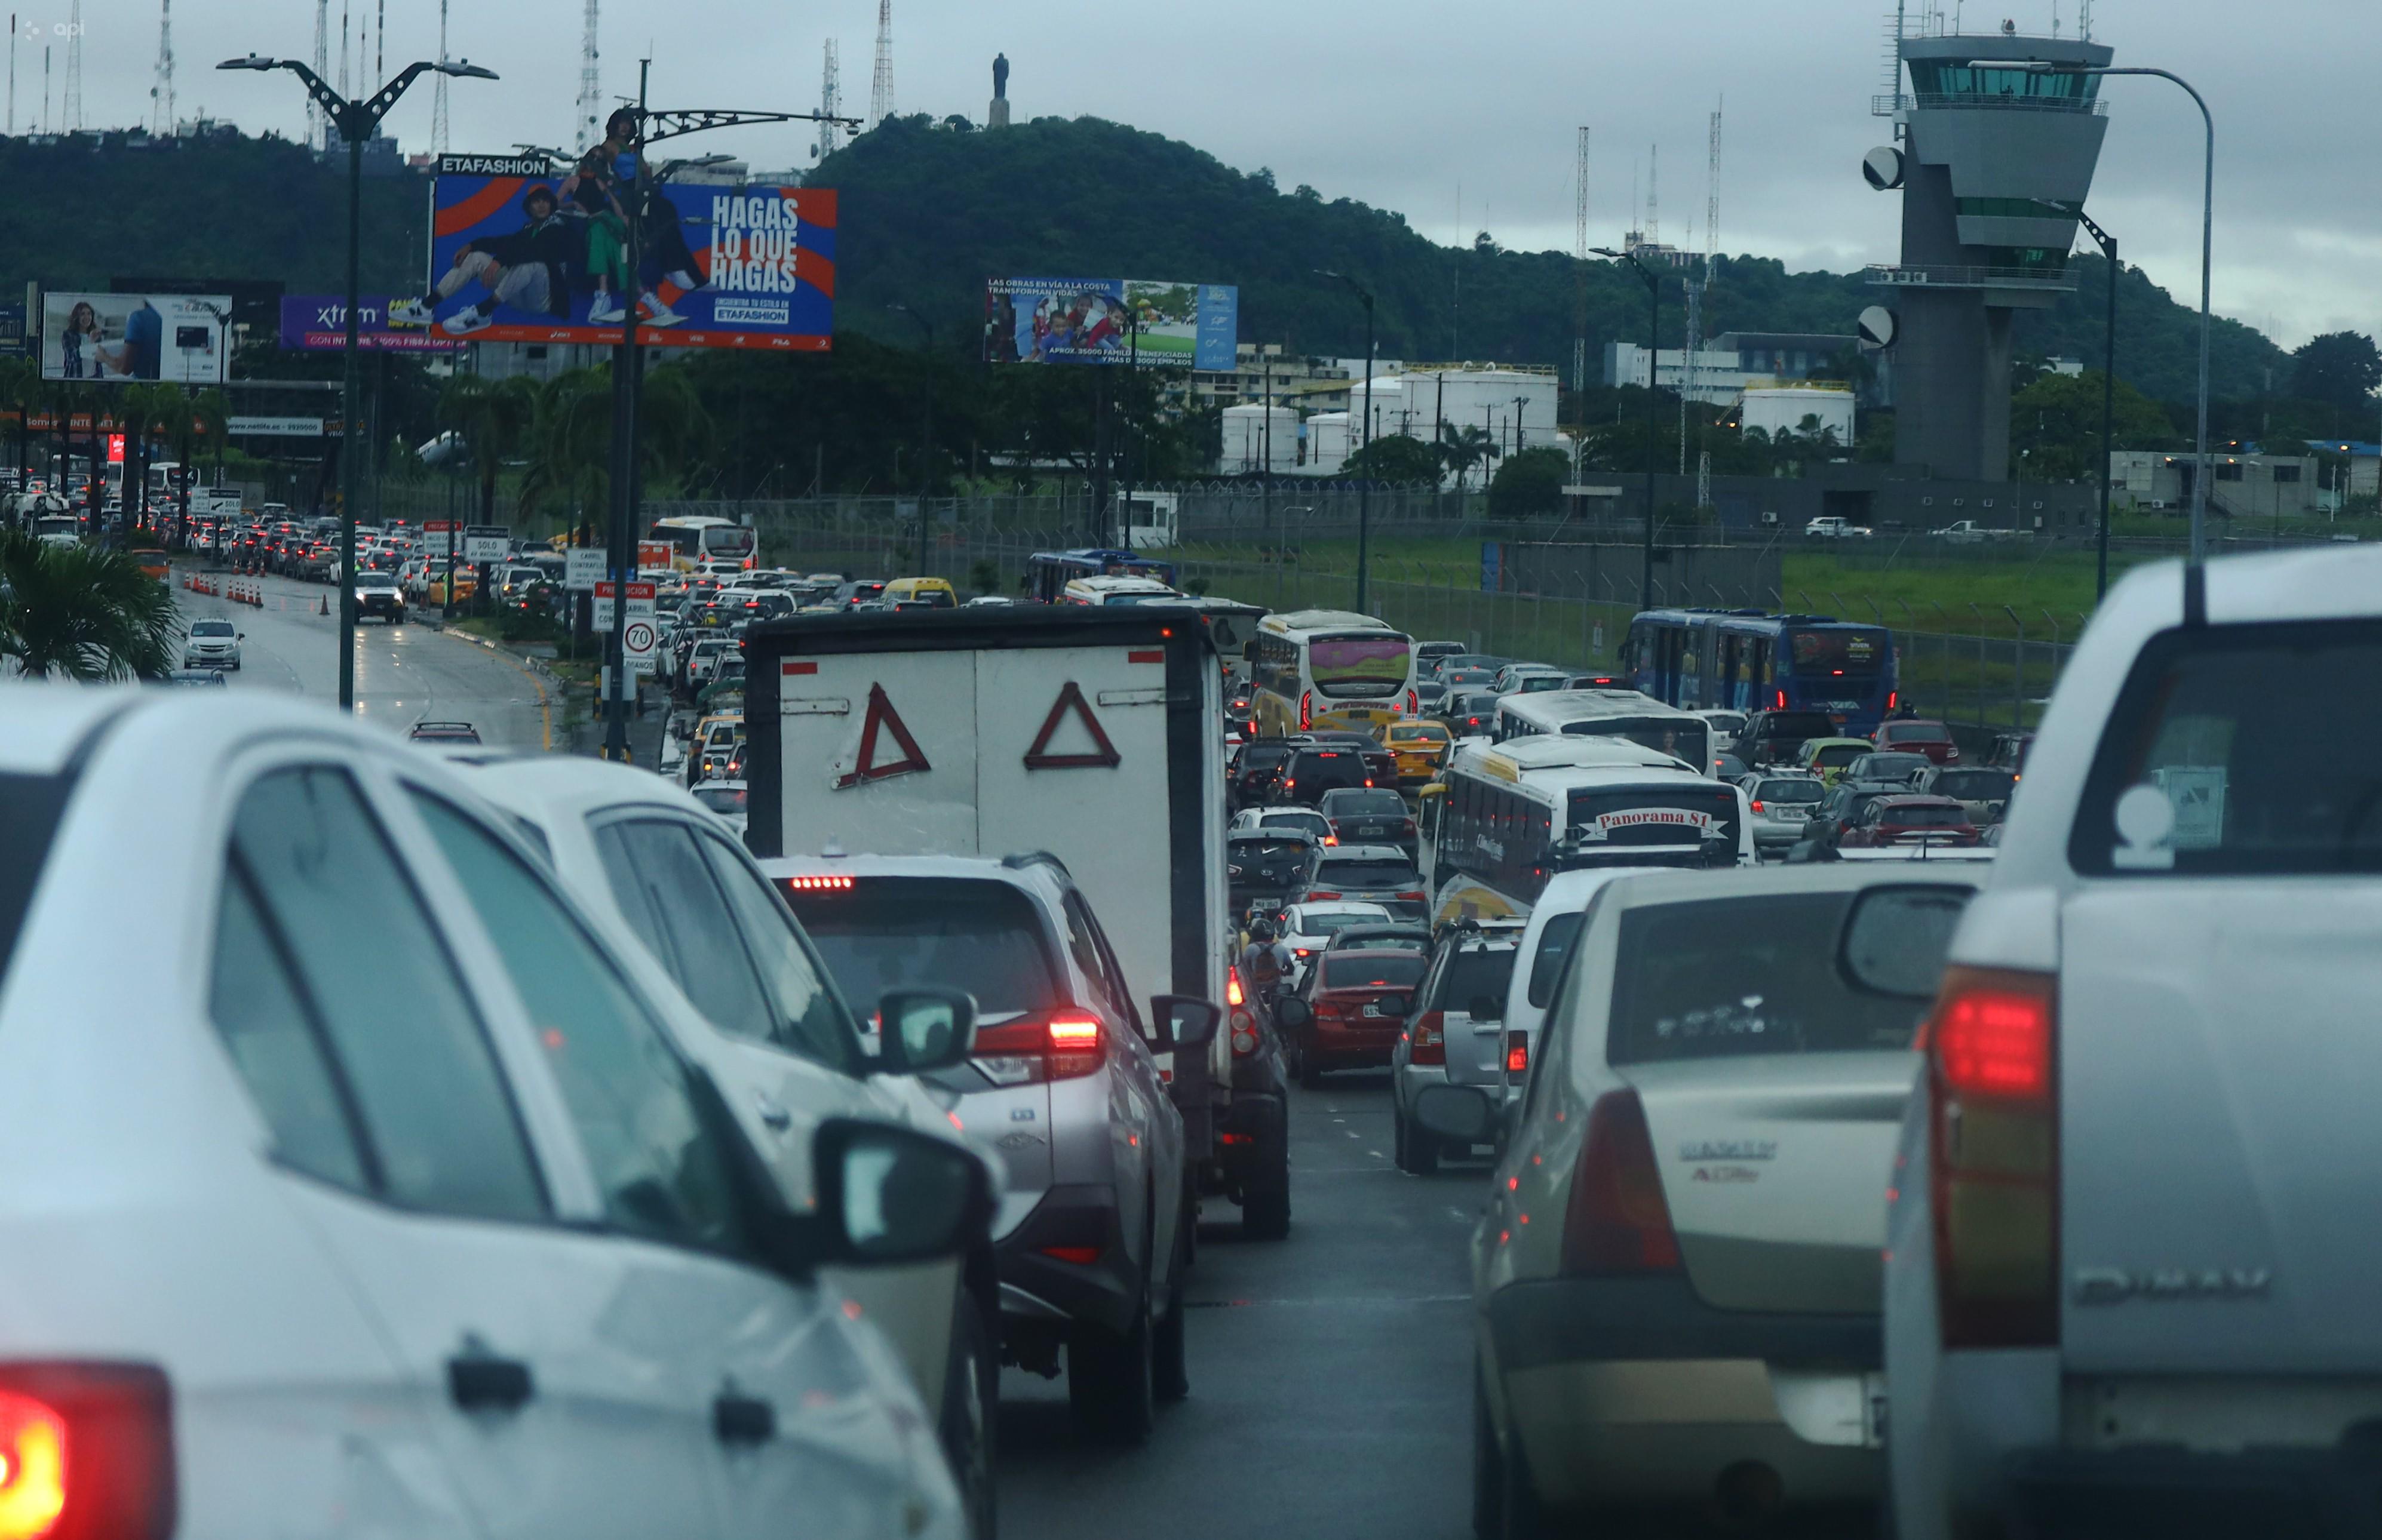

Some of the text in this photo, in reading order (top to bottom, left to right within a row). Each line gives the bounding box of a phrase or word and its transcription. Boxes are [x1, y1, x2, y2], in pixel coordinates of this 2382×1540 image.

[441, 157, 547, 175] ETAFASHION
[712, 195, 799, 230] HAGAS
[710, 225, 799, 263] LO QUE
[709, 258, 797, 294] HAGAS
[988, 278, 1005, 287] LAS
[1006, 279, 1035, 288] OBRAS
[1048, 279, 1062, 288] VÍA
[988, 287, 1078, 297] TRANSFORMAN VIDAS
[750, 299, 760, 307] TU
[760, 299, 779, 308] ESTILO
[781, 300, 790, 309] EN
[317, 304, 377, 329] xtrm
[717, 309, 785, 321] ETAFASHION
[310, 336, 330, 346] CON
[404, 337, 430, 347] FIBRA
[1049, 346, 1077, 355] APROX.
[1078, 348, 1102, 356] 35000
[1139, 350, 1193, 359] BENEFICIADAS
[1157, 358, 1193, 366] EMPLEOS
[478, 540, 498, 550] SOLO
[601, 585, 648, 596] PREUCION
[631, 630, 648, 645] 70
[1599, 812, 1708, 829] Panorama 81
